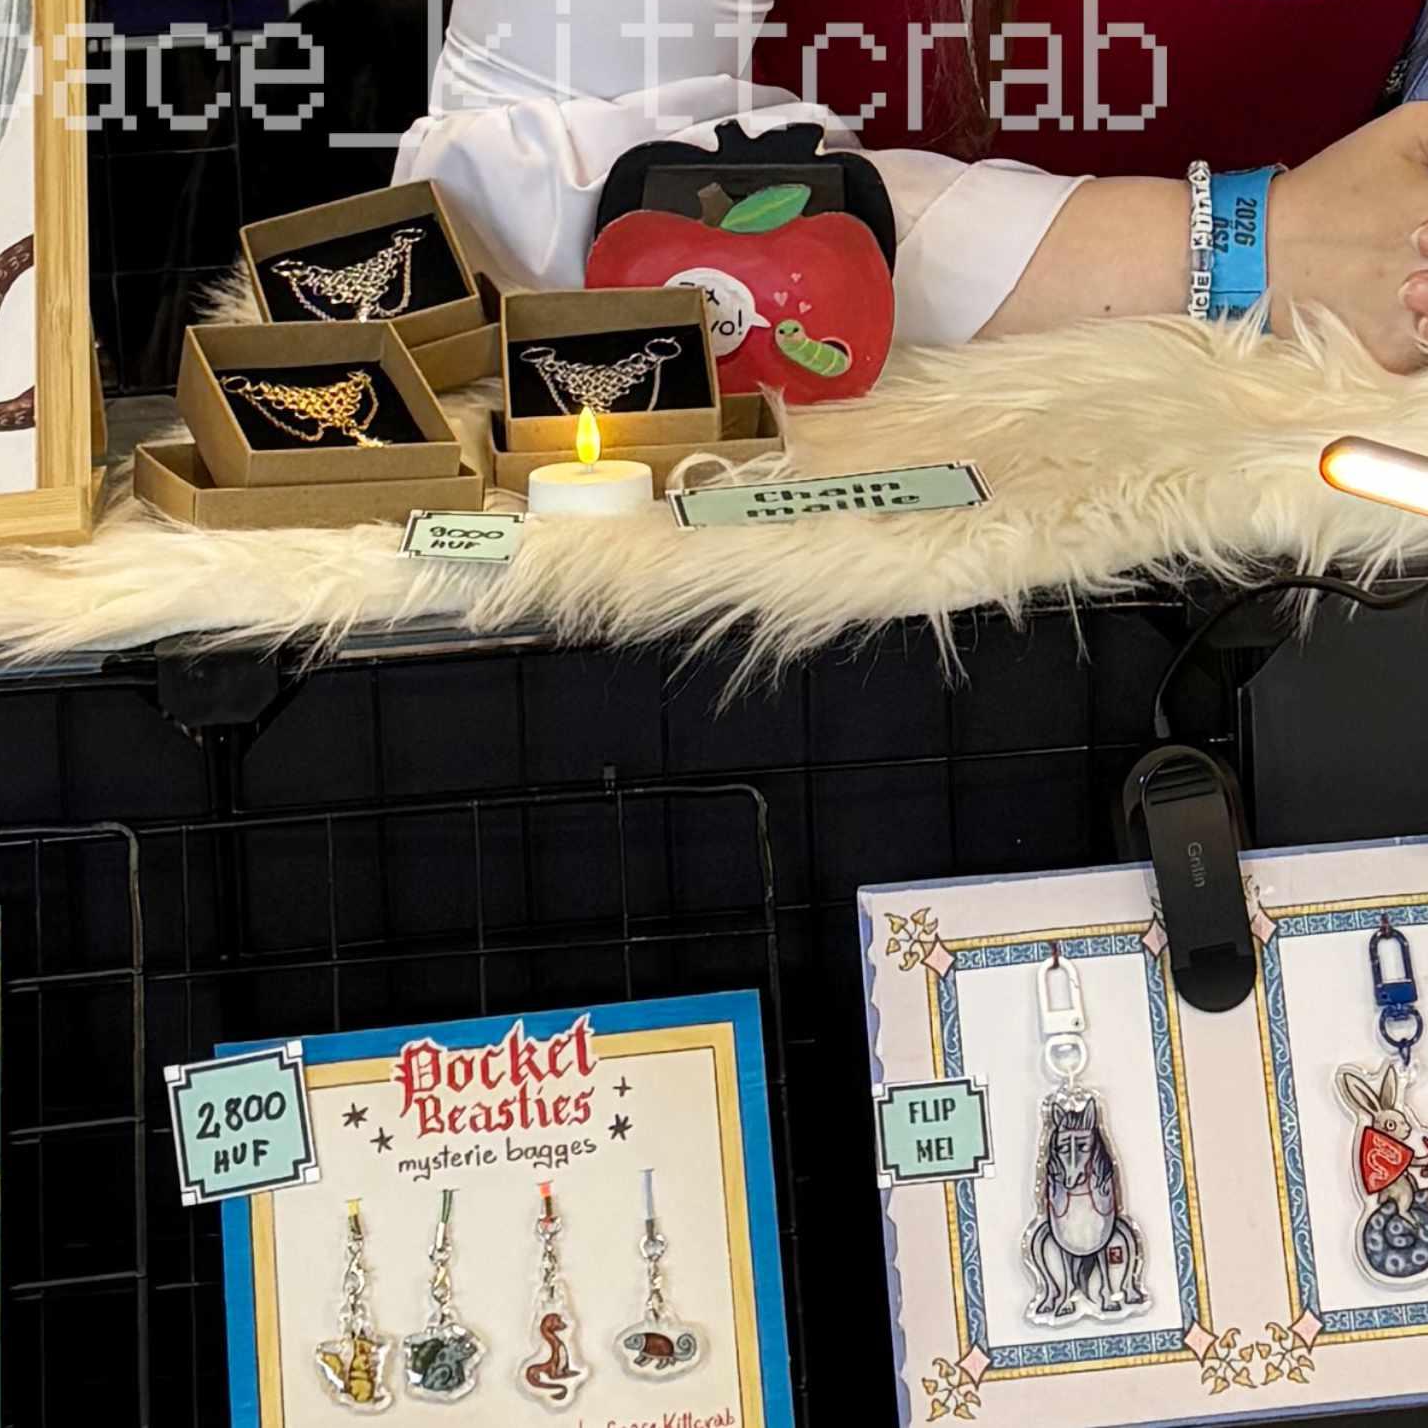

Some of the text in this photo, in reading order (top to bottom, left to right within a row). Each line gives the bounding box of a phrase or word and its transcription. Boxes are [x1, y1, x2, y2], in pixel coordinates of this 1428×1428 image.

[1235, 197, 1257, 247] 2026
[396, 1017, 598, 1114] Pocket
[197, 1094, 286, 1142] 2800
[417, 1086, 595, 1137] Beasties
[908, 1099, 956, 1126] FLIP
[213, 1141, 270, 1174] HUF
[397, 1137, 597, 1180] mysterie bagges
[916, 1137, 955, 1164] ME!
